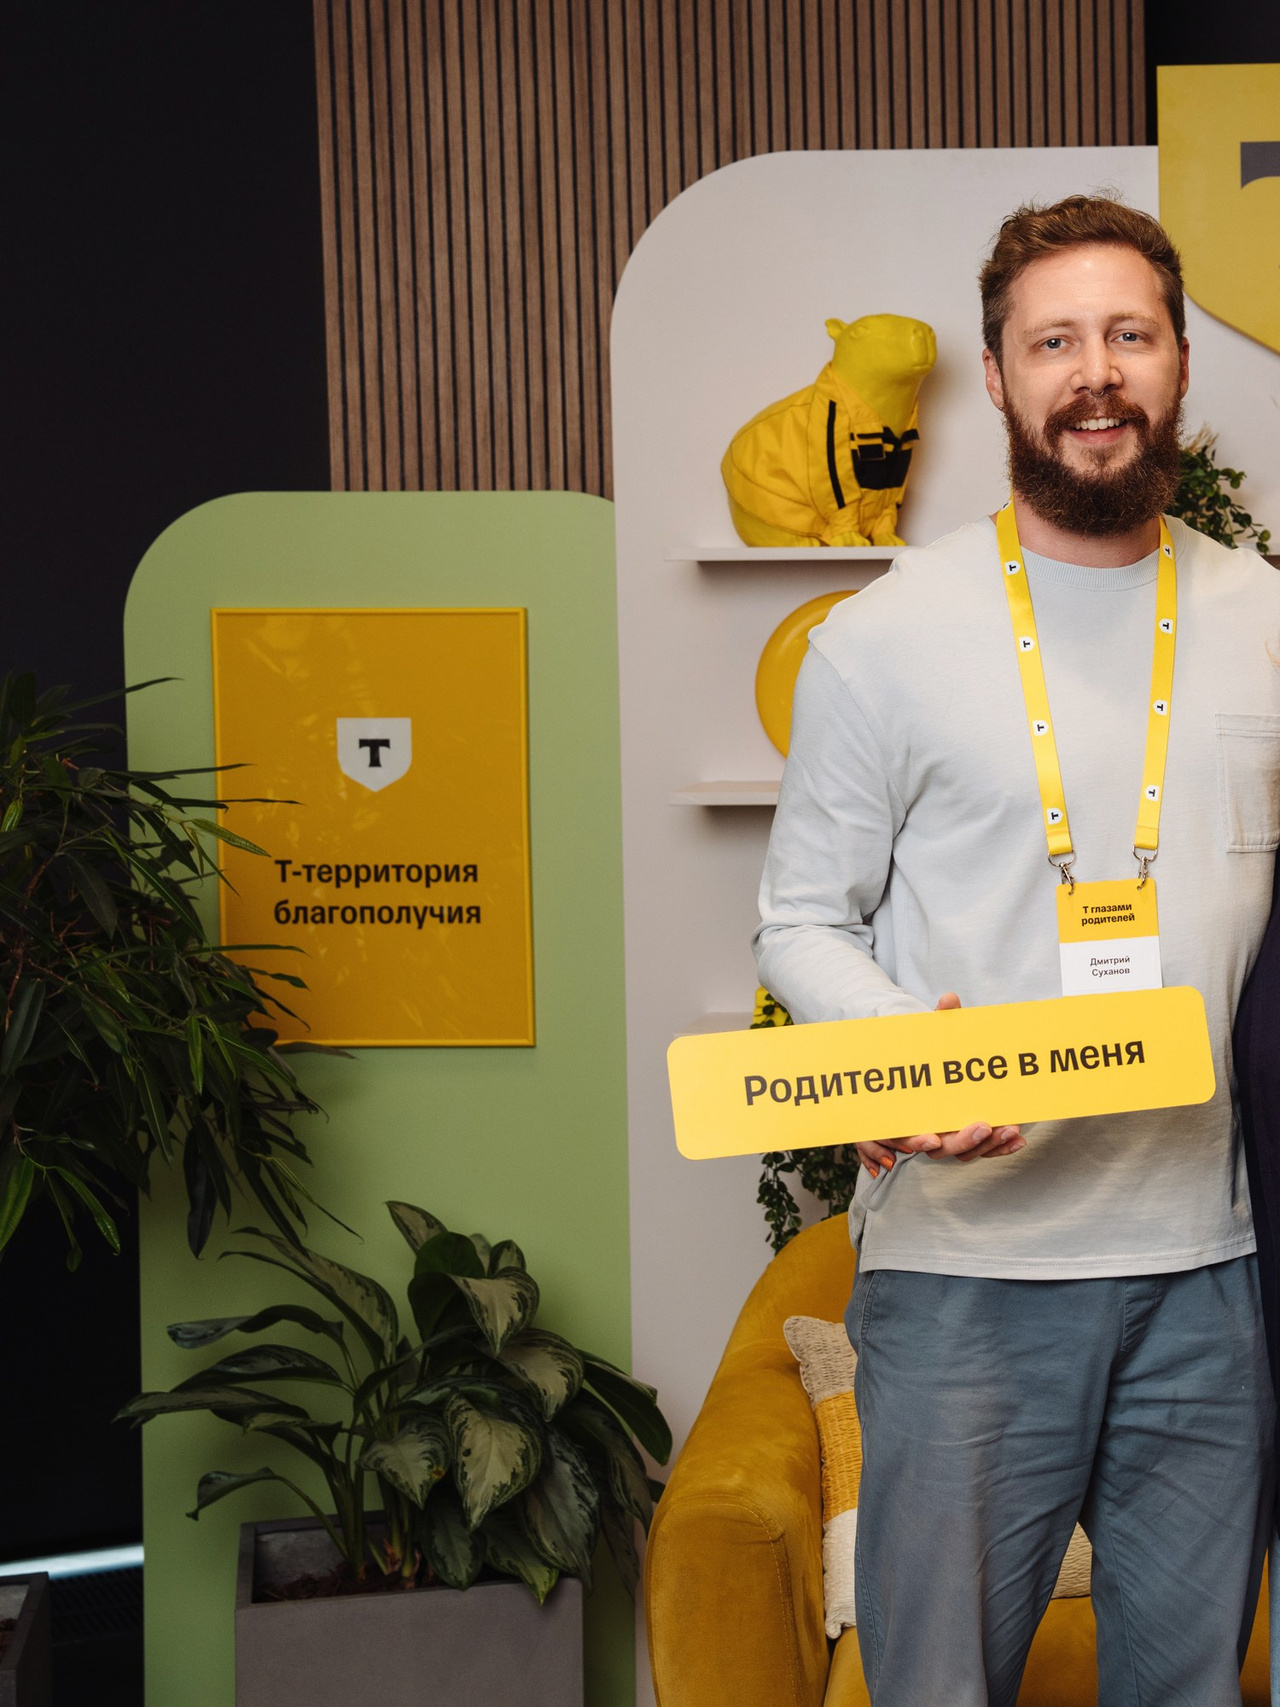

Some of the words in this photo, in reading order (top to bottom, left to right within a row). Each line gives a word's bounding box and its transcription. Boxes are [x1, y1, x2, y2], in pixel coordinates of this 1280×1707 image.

[359, 739, 390, 767] Т
[274, 860, 477, 888] Т-территория
[274, 900, 481, 929] благополучия
[1082, 905, 1089, 914] Т
[1091, 903, 1132, 913] глазами
[1082, 913, 1135, 926] родителей
[1090, 956, 1131, 967] Дмитрий
[1091, 967, 1131, 977] Суханов
[745, 1064, 931, 1106] Родители
[943, 1056, 1007, 1084] все
[1019, 1053, 1039, 1076] в
[1051, 1041, 1144, 1073] меня
